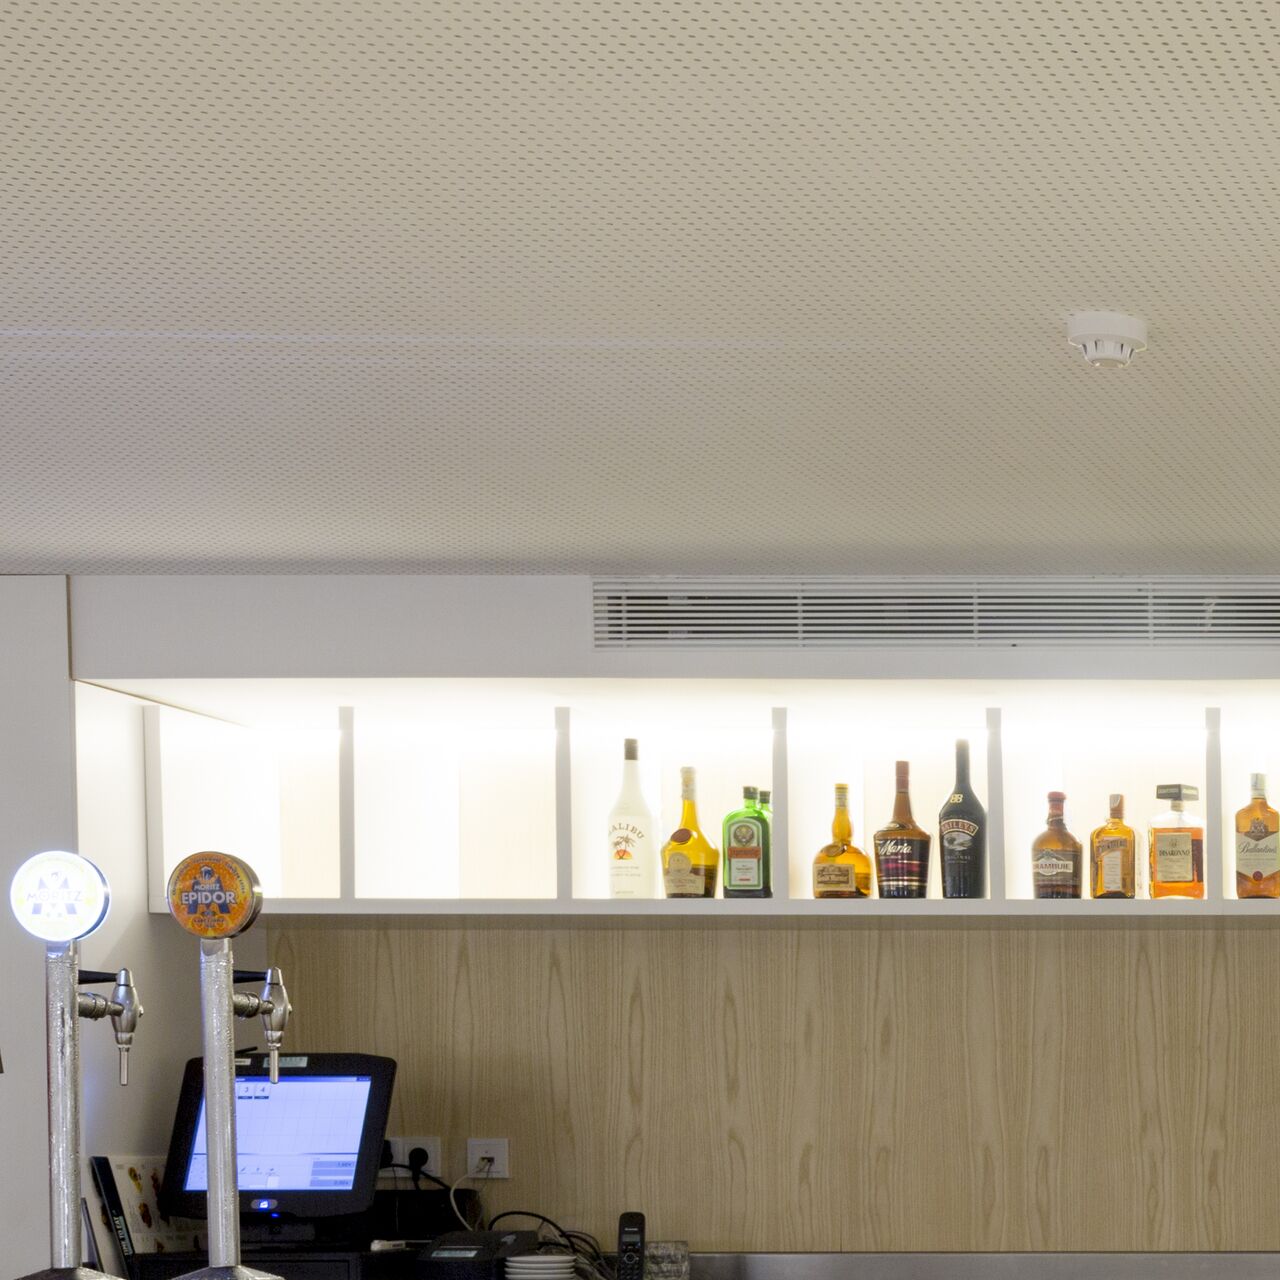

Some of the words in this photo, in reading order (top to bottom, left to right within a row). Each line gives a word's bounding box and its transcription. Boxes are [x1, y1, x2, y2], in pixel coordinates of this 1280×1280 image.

[880, 840, 912, 854] Maria
[1159, 849, 1191, 857] DISARONNO
[181, 891, 236, 905] EPIDOR
